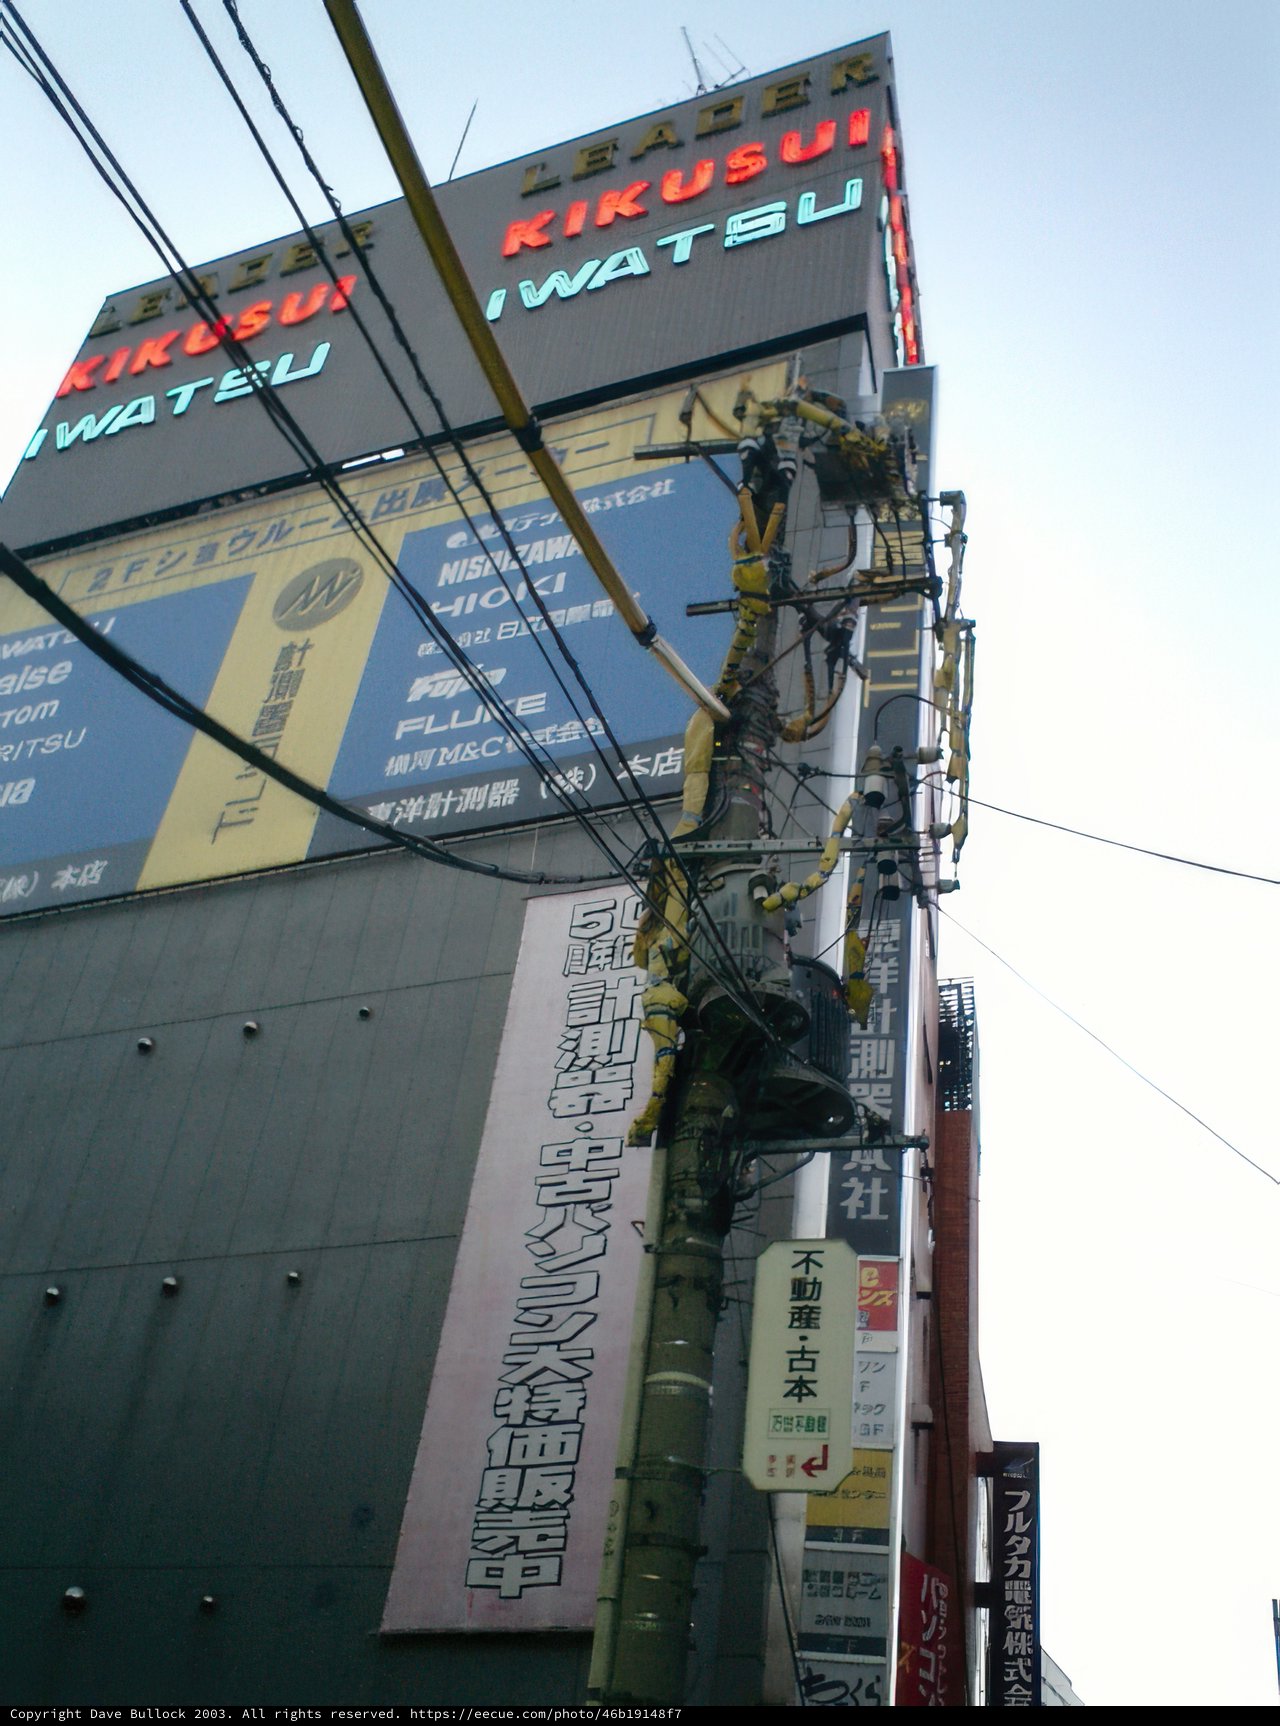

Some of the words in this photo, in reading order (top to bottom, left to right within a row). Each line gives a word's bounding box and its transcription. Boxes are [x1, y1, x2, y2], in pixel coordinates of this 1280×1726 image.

[502, 108, 872, 257] KIKUSUI
[520, 51, 881, 197] LEADER
[486, 178, 864, 322] IWATSU
[24, 341, 332, 460] IWATSU
[56, 275, 357, 398] KIKUSUI
[430, 572, 567, 618] HIOKI
[395, 692, 547, 741] FLUKE
[783, 1249, 826, 1404] 不動産・古本
